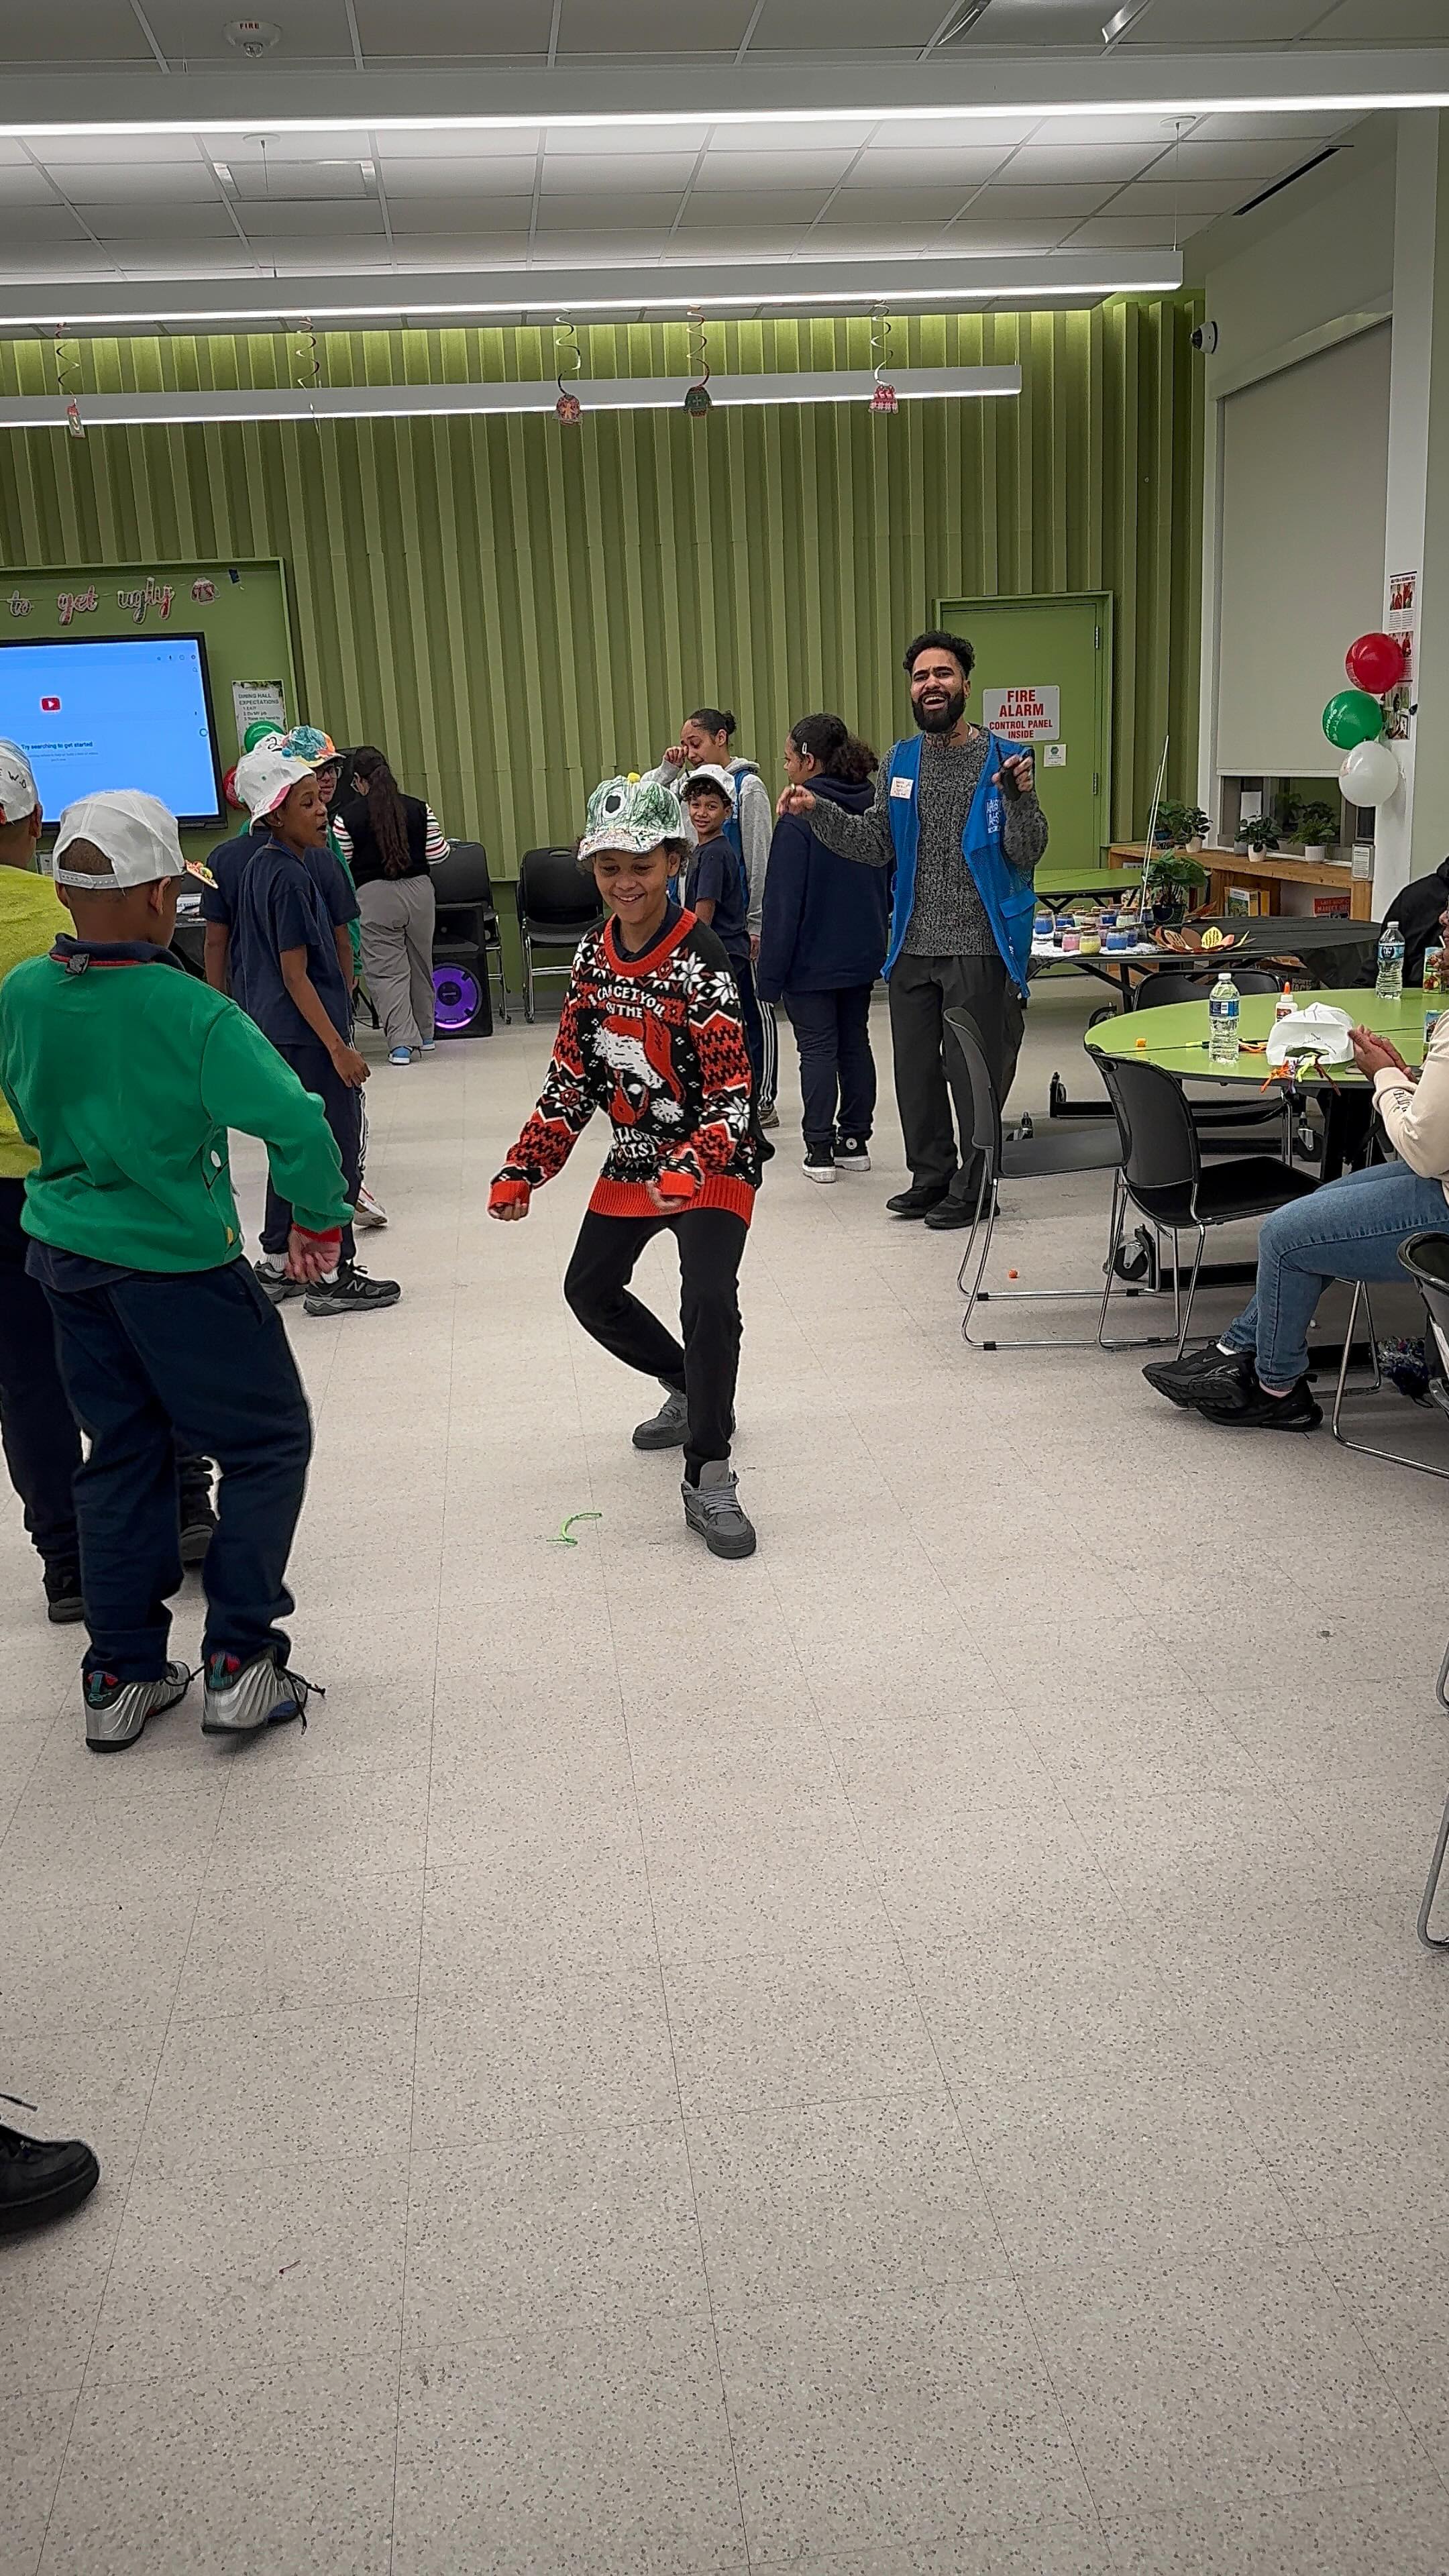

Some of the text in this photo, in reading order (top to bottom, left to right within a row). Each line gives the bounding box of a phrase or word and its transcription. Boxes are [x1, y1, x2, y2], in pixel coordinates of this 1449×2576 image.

[7, 577, 174, 626] to get ugly
[1008, 690, 1036, 702] FIRE
[999, 703, 1044, 717] ALARM
[989, 718, 1053, 731] CONTROL PANEL
[1008, 730, 1034, 739] INSIDE
[613, 985, 641, 1001] GET
[639, 991, 665, 1018] YOU
[616, 1004, 643, 1018] THE
